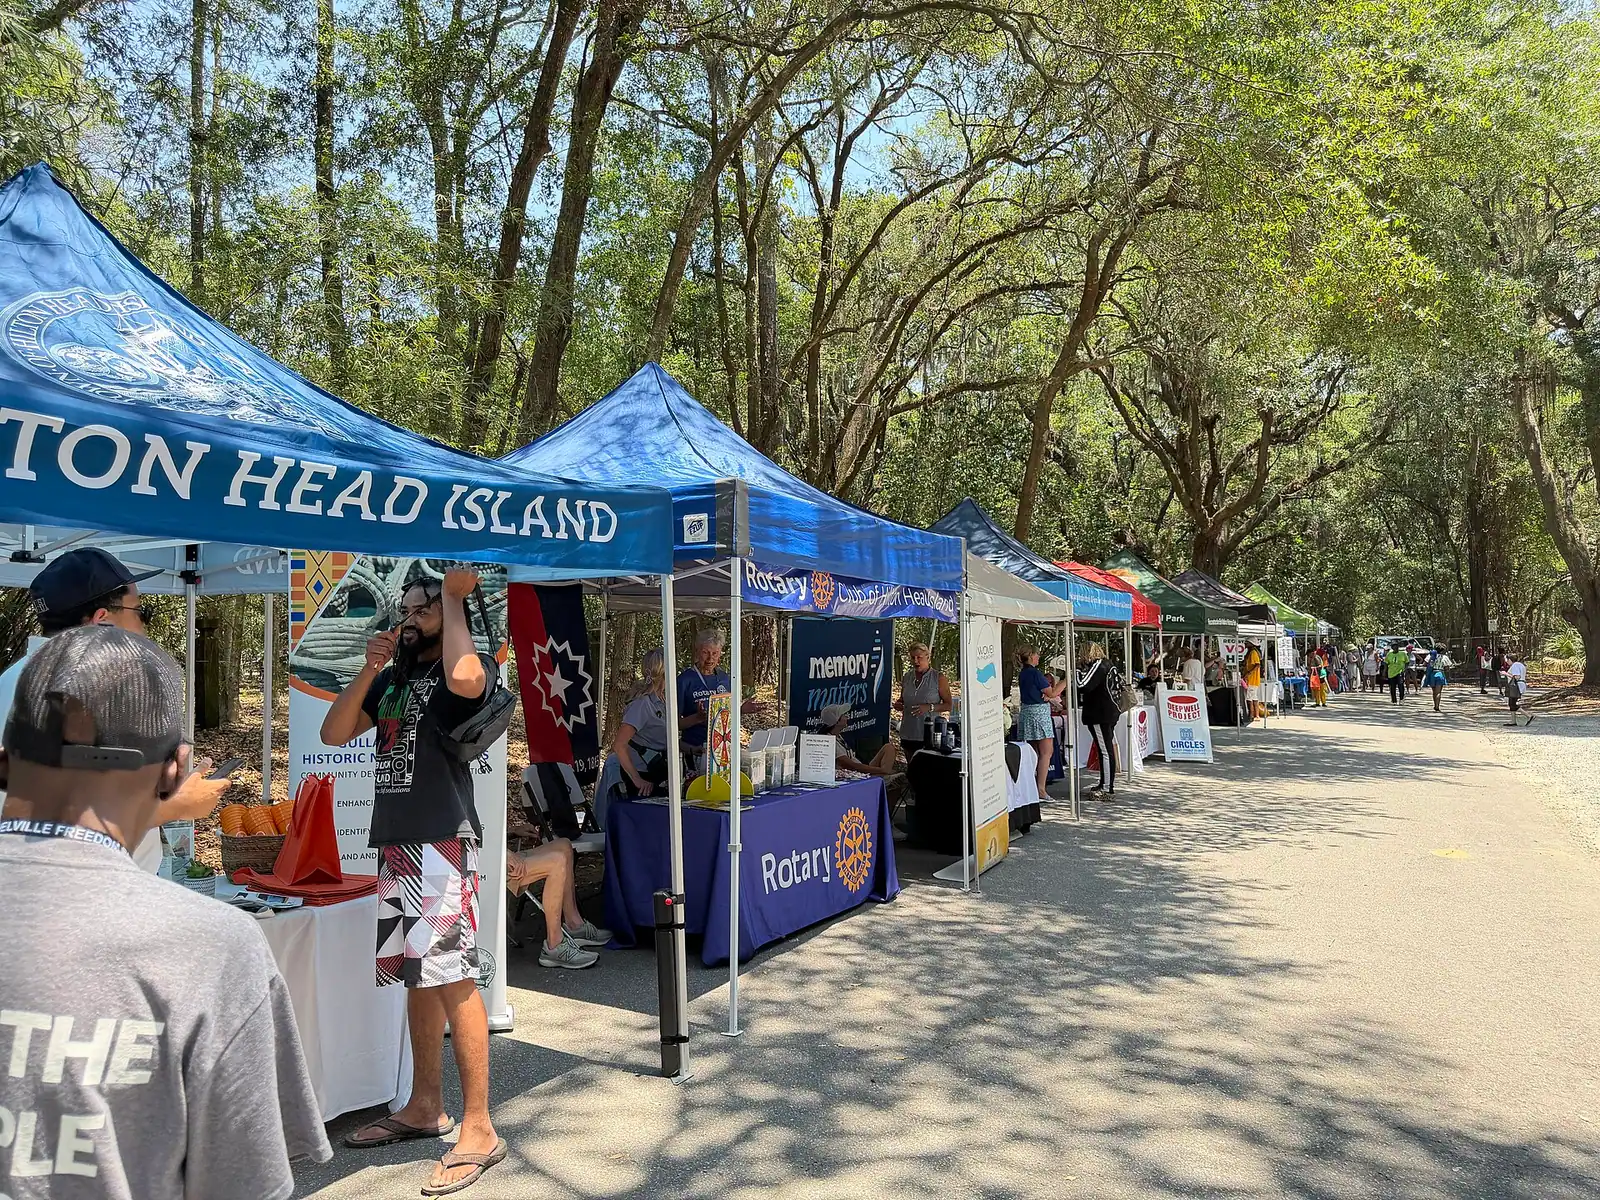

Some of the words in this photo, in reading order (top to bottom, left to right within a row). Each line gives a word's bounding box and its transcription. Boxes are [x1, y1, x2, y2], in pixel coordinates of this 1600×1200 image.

[9, 304, 54, 350] HILTON
[0, 406, 210, 500] TON
[224, 448, 429, 525] HEAD
[441, 482, 618, 544] ISLAND
[745, 561, 807, 601] Rotary
[838, 582, 866, 603] Club
[869, 585, 880, 605] of
[1166, 614, 1185, 622] Park
[809, 653, 870, 679] memory
[807, 680, 868, 712] matters
[1168, 709, 1201, 720] PROJECT
[1170, 740, 1205, 749] CIRCLES
[302, 753, 366, 764] HISTORIC
[574, 758, 587, 773] 19,
[337, 799, 374, 808] ENHANC
[340, 853, 359, 861] AND
[360, 852, 377, 860] AND
[761, 845, 830, 894] Rotary
[0, 1009, 164, 1086] THE
